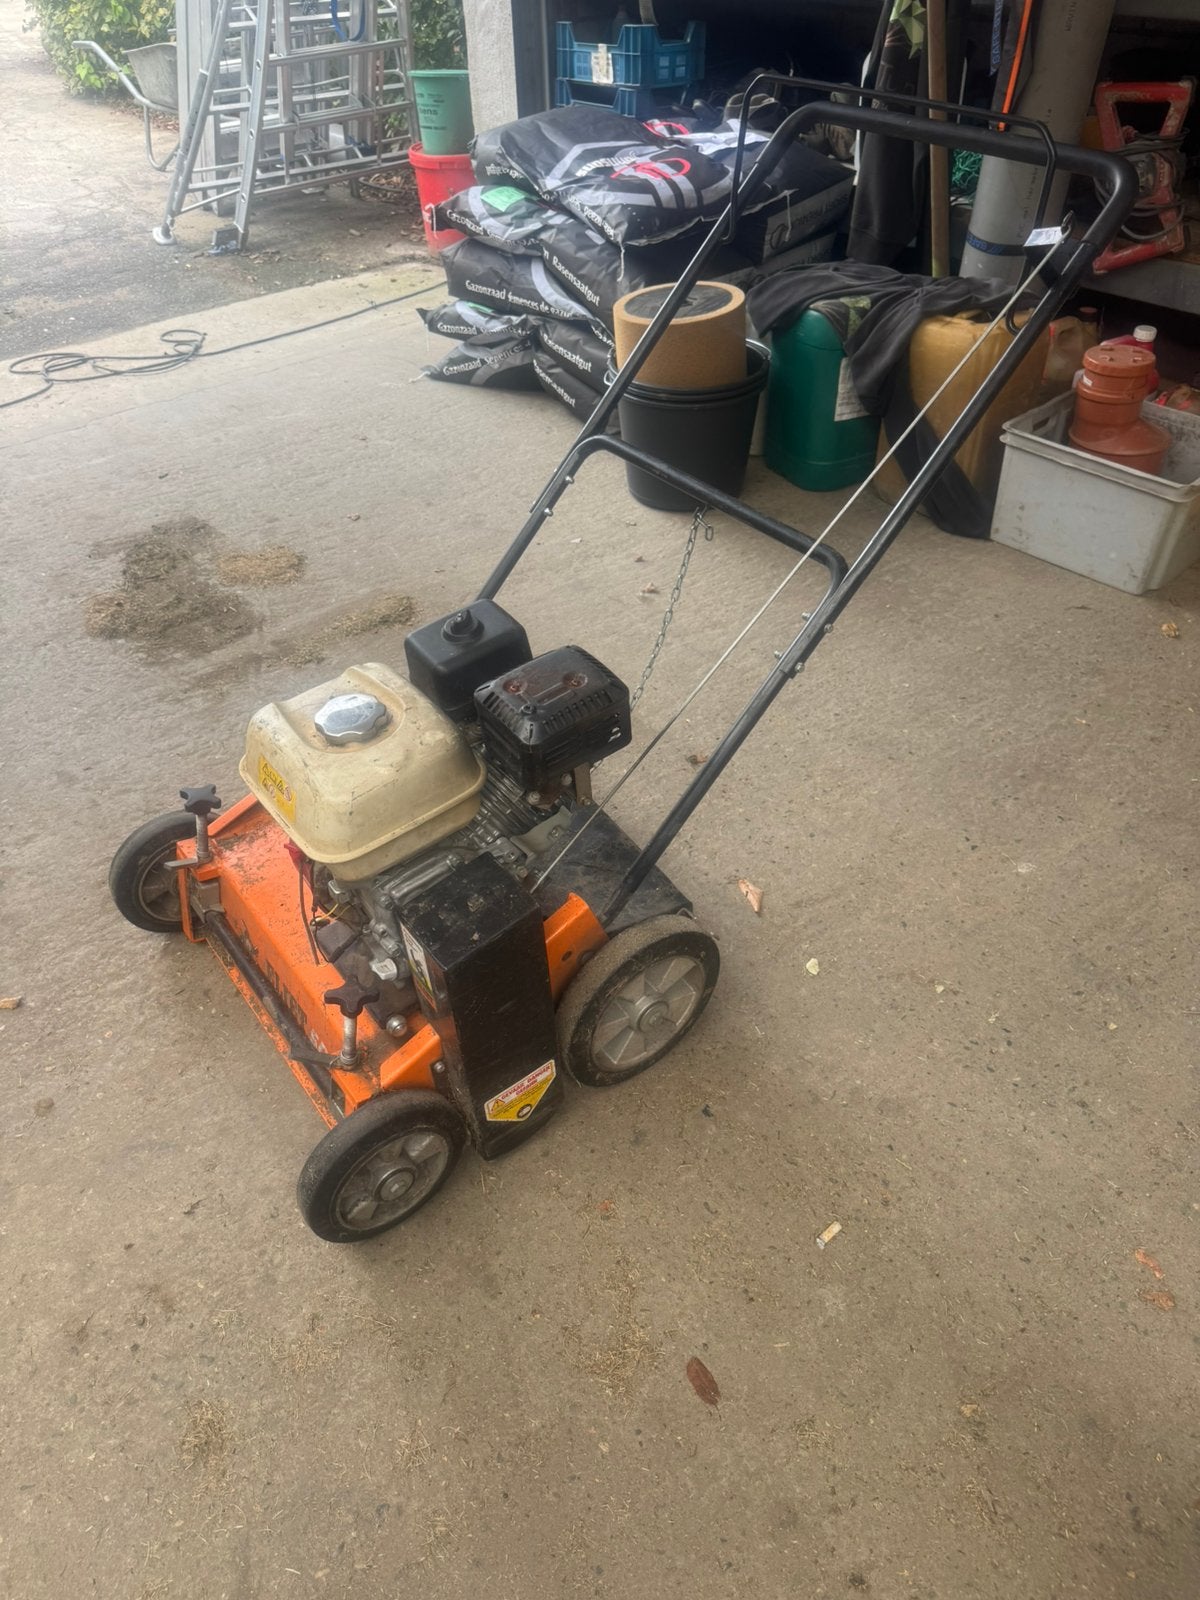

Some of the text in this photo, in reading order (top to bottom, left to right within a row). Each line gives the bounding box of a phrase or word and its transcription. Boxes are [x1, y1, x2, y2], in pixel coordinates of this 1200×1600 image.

[465, 280, 506, 300] Gazonzaad
[552, 255, 600, 307] Rasensaatgut
[437, 322, 478, 336] Gazonzaad
